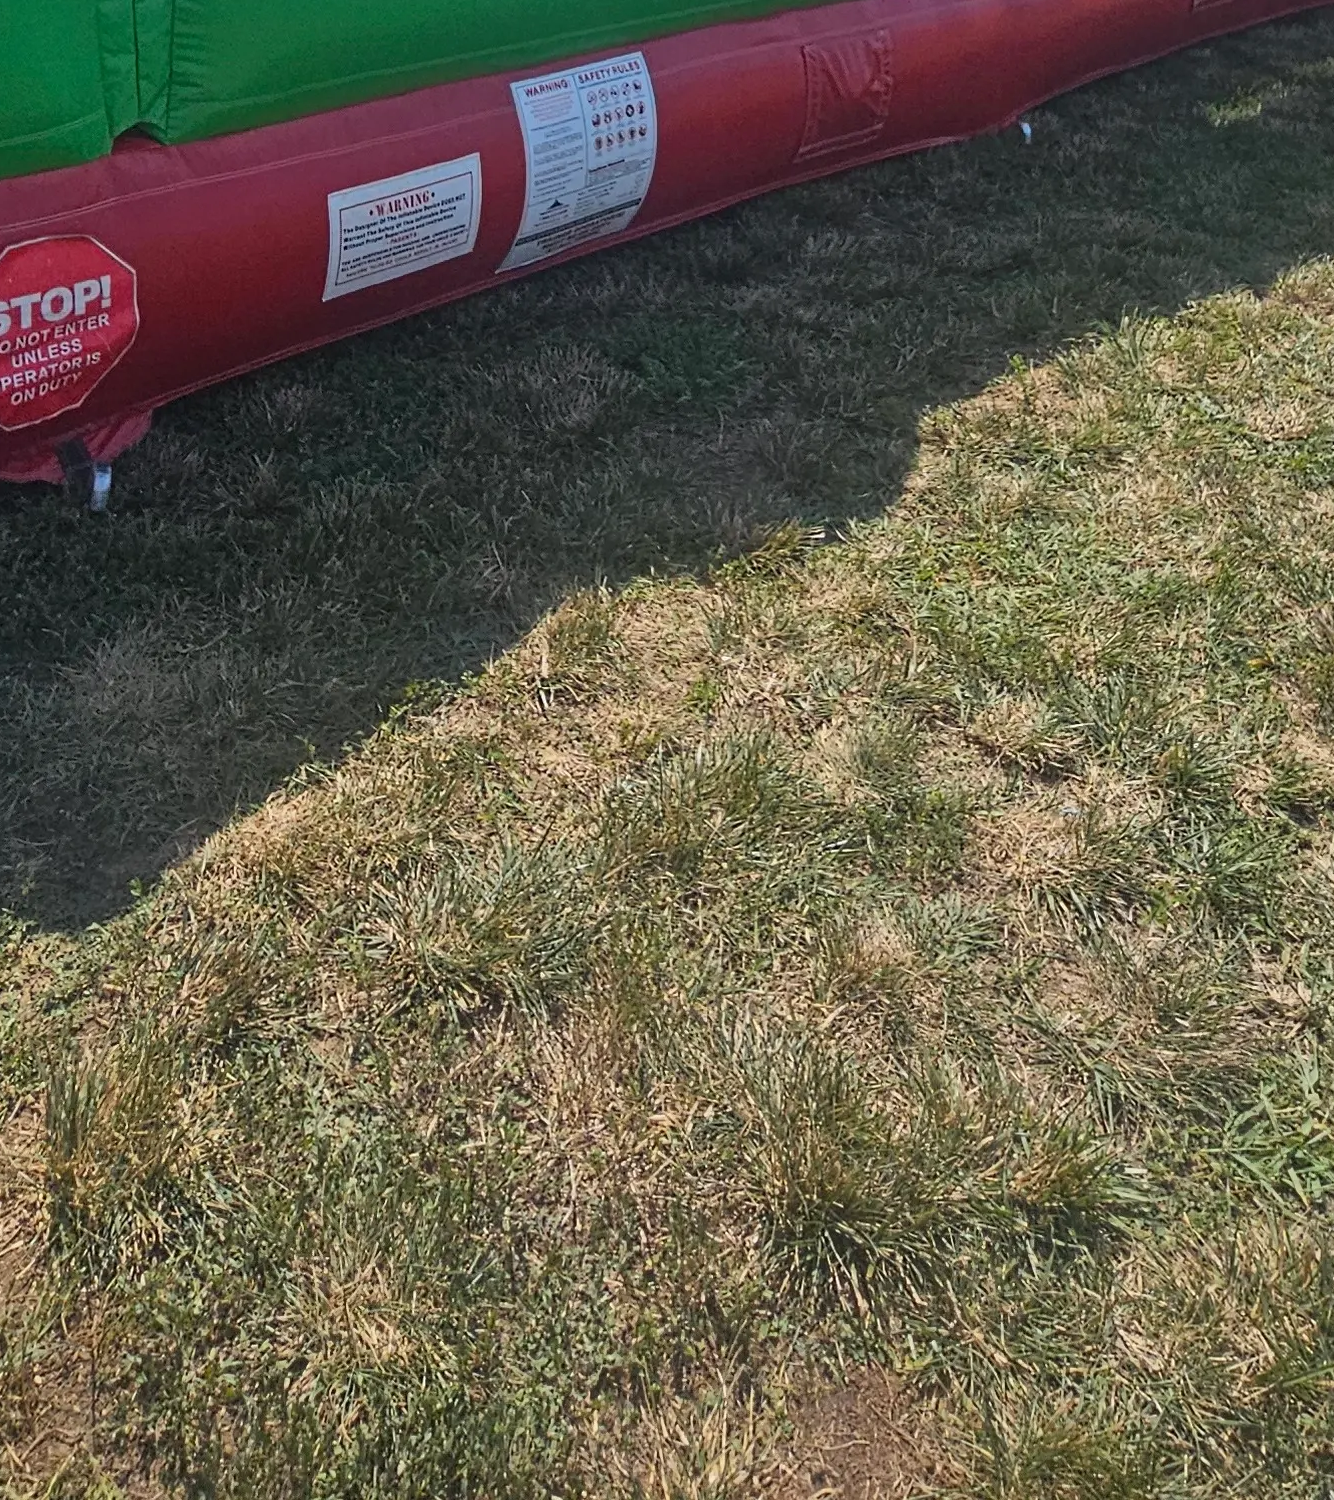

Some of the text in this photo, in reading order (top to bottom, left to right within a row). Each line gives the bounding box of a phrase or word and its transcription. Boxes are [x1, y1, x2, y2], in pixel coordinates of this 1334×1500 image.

[578, 60, 640, 84] SAFETY RULES
[375, 190, 430, 216] WARNING
[15, 329, 50, 350] NOT
[54, 313, 110, 338] ENTER
[11, 338, 83, 368] UNLESS
[87, 351, 101, 365] IS
[11, 371, 83, 406] ON DUTY
